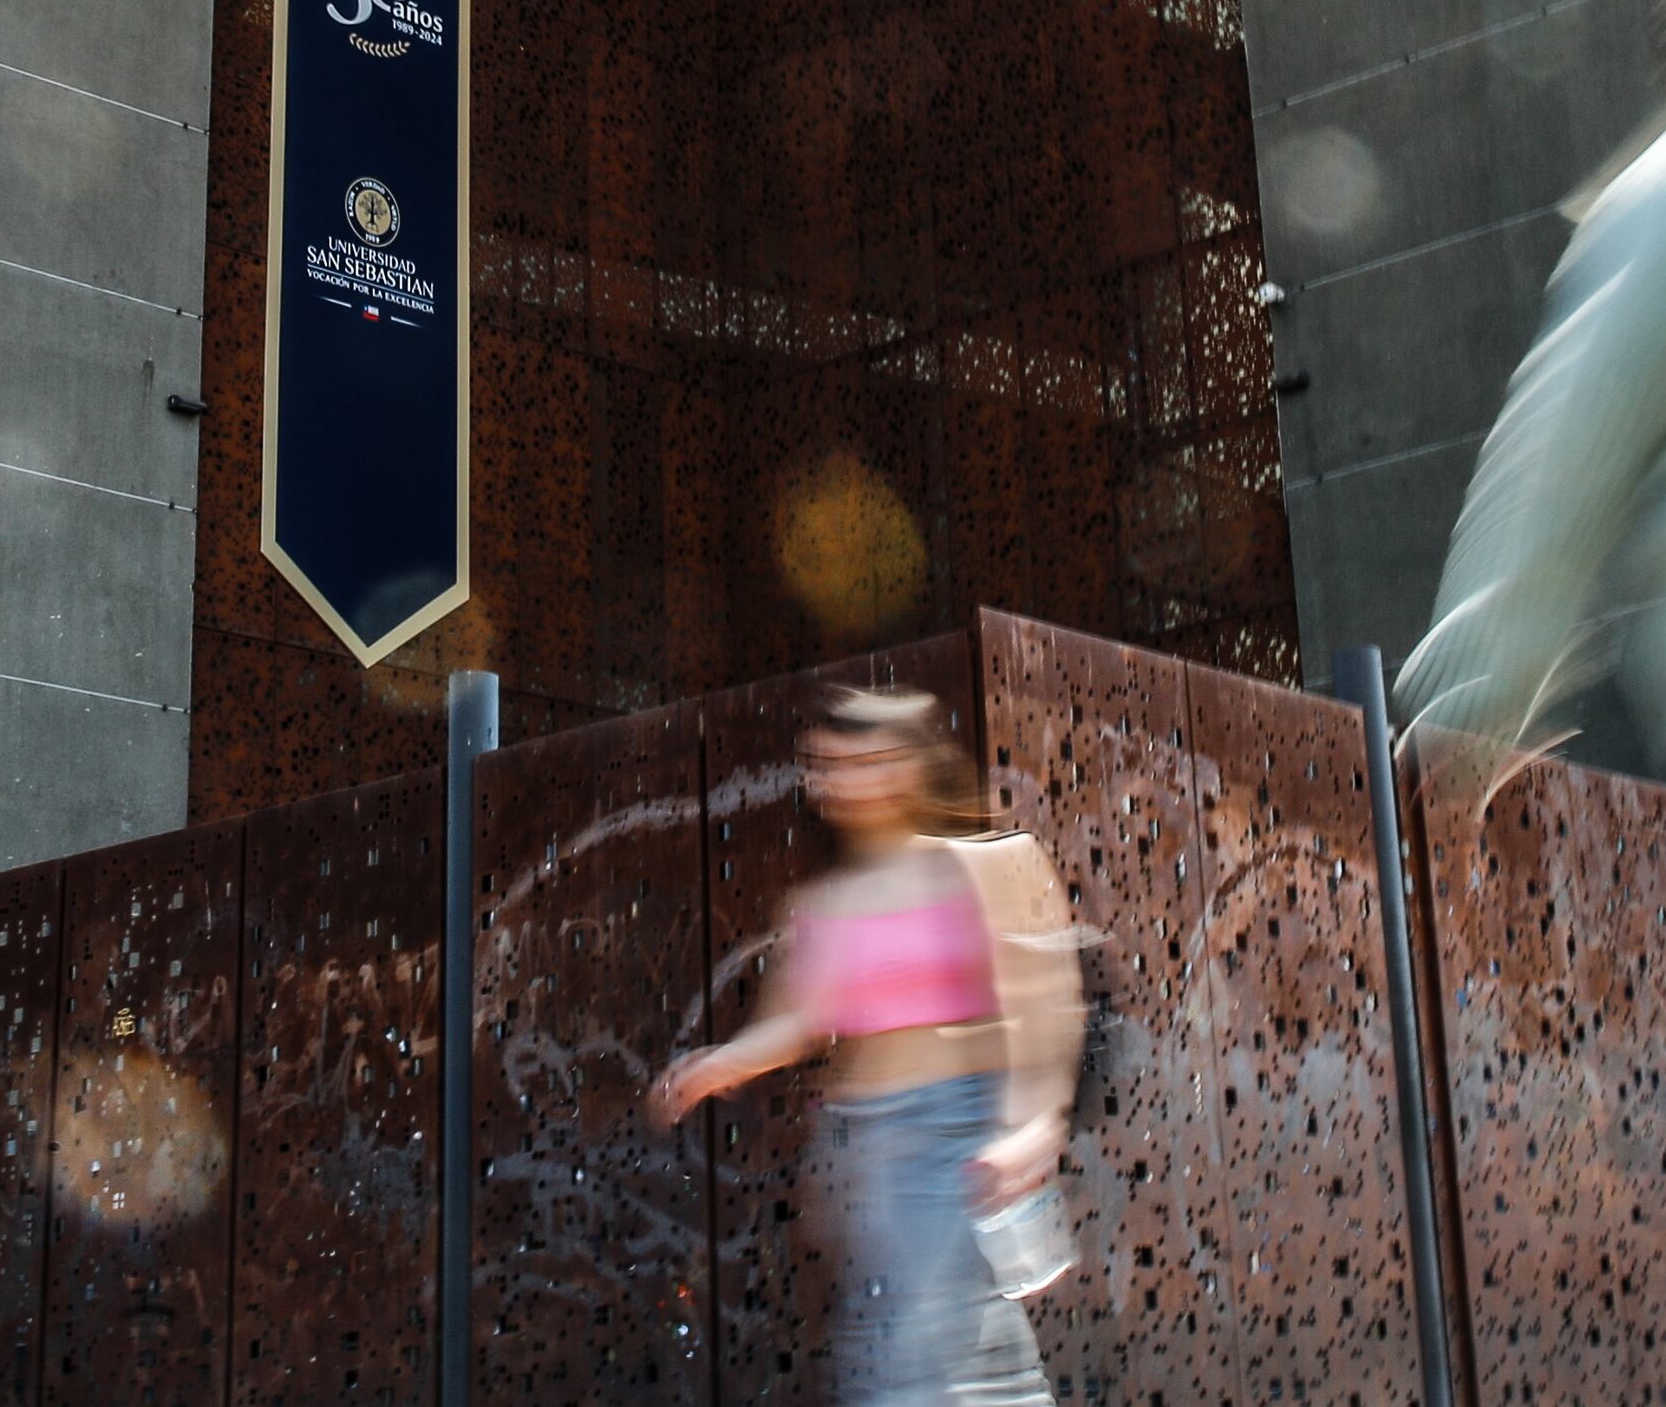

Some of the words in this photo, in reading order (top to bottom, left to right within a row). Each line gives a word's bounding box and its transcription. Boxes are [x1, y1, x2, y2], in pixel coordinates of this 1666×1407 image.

[392, 1, 443, 33] años
[306, 246, 340, 270] SAN
[344, 258, 434, 298] SEBASTIAN
[328, 236, 416, 275] UNIVERSIDAD
[307, 268, 350, 289] VOCACIÓN
[353, 284, 369, 295] POR
[372, 288, 383, 298] LA
[385, 292, 435, 314] EXCELENCIA
